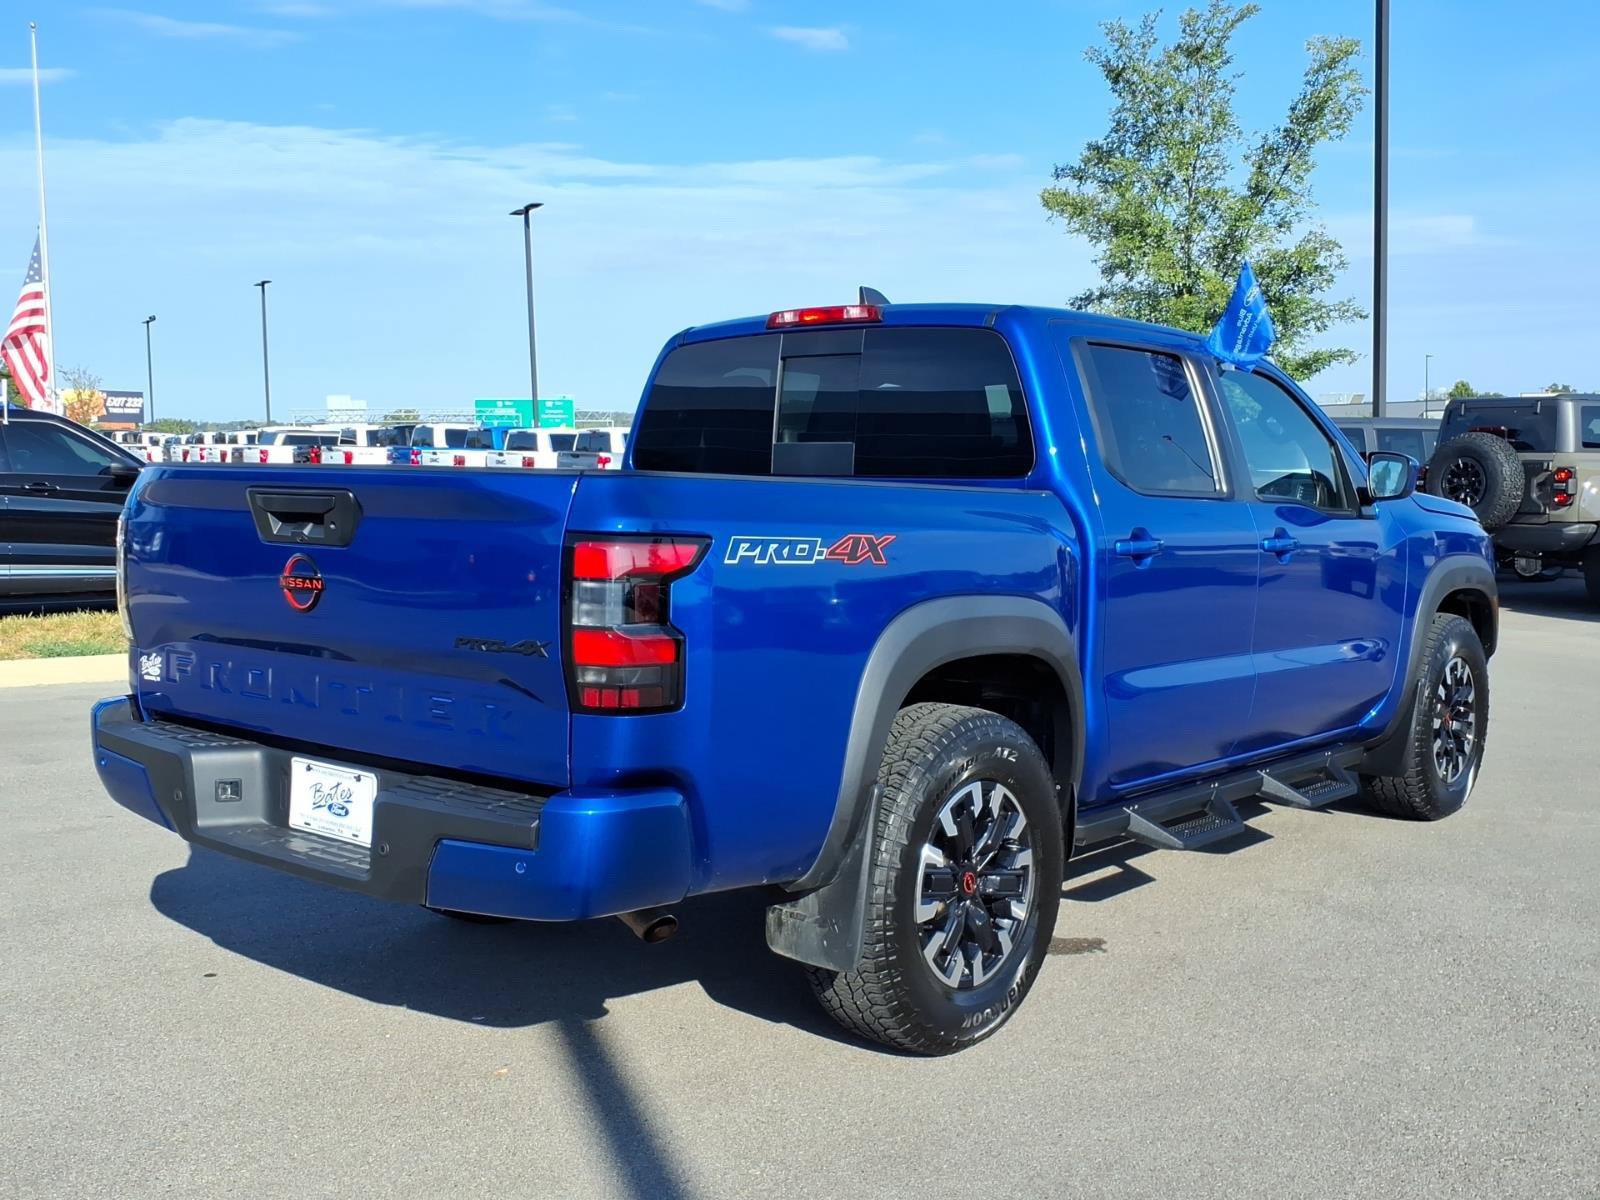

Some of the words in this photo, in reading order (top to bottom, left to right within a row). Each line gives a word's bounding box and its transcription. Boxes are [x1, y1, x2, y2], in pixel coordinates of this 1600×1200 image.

[280, 577, 322, 589] NISSAN
[164, 646, 516, 742] FRONTIER
[309, 782, 353, 806] Bates
